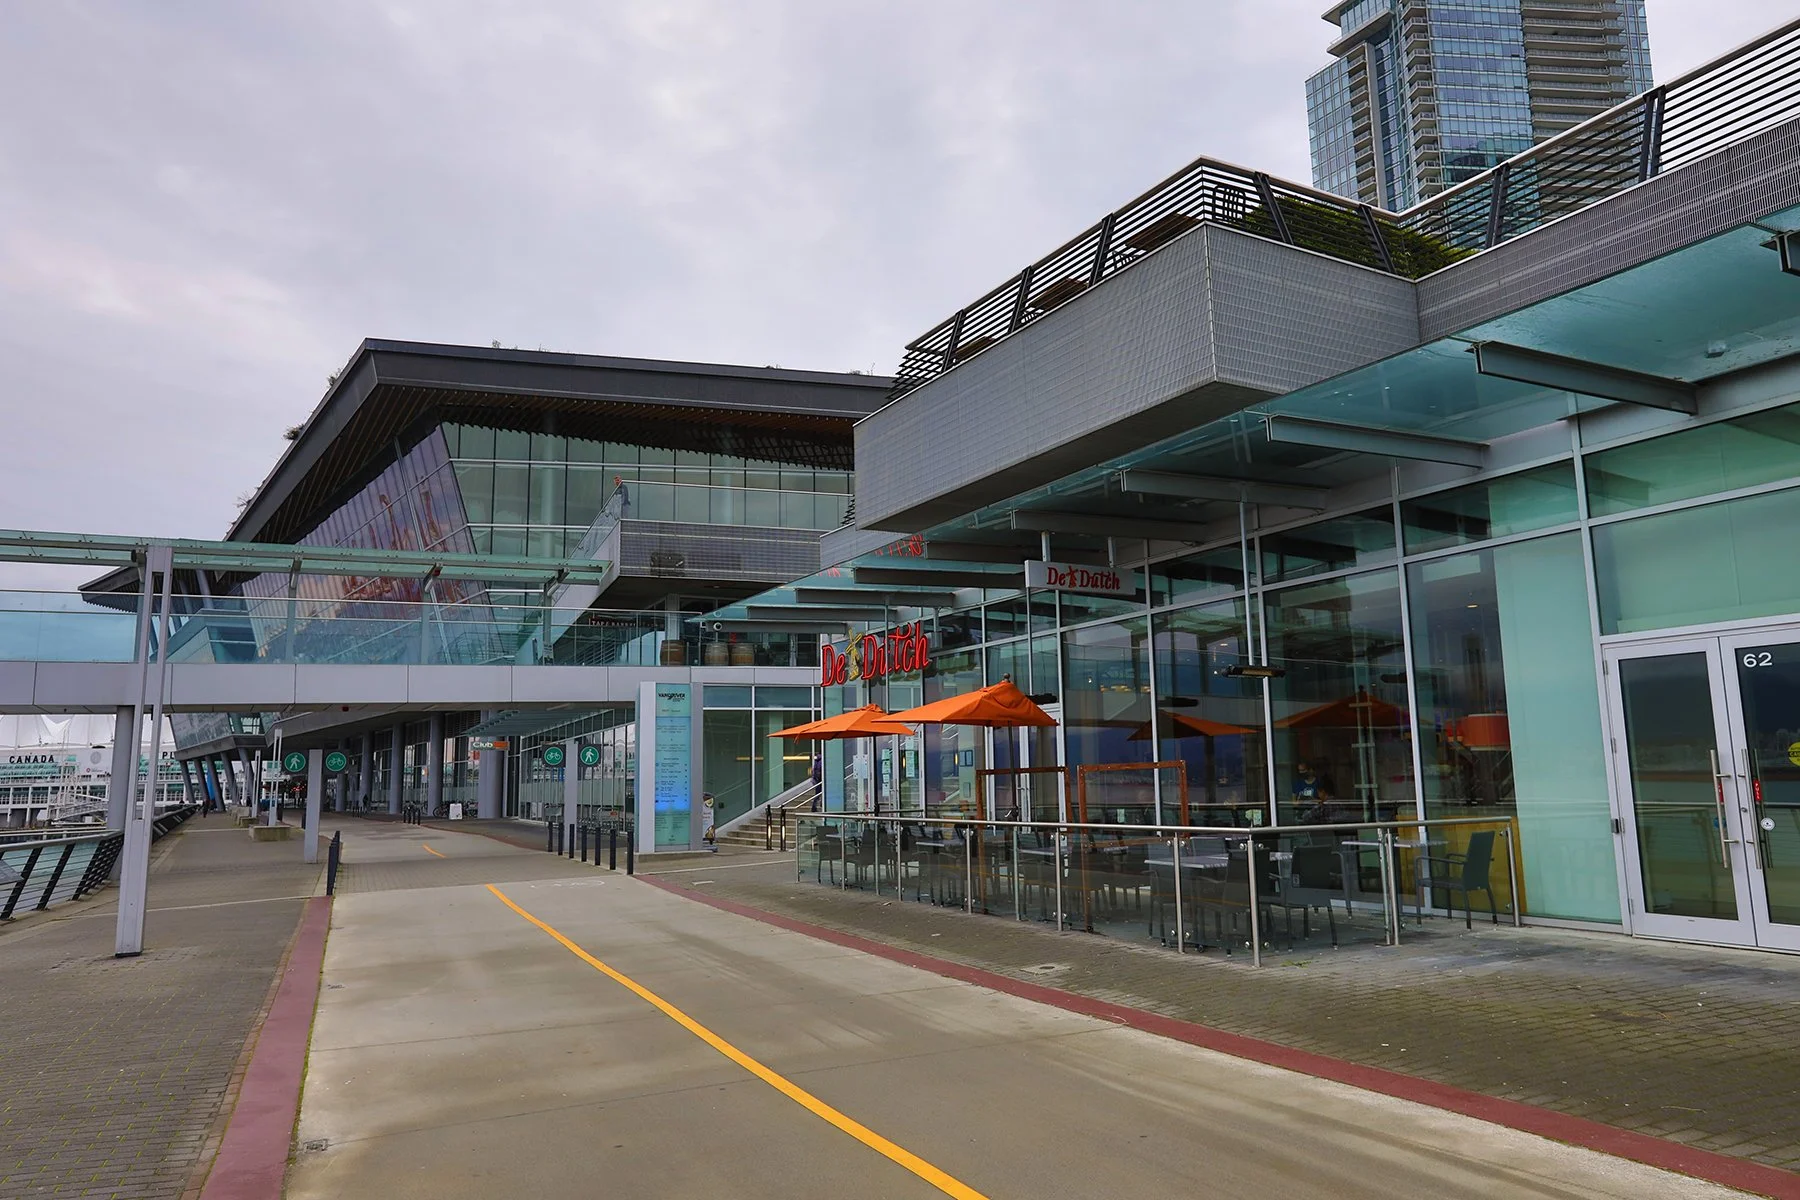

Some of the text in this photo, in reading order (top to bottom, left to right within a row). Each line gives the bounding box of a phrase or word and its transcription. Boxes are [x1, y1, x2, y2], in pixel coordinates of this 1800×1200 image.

[1047, 567, 1121, 591] De Dutch
[821, 620, 929, 687] De Dutch
[1743, 652, 1773, 668] 62
[9, 755, 55, 763] CANADA
